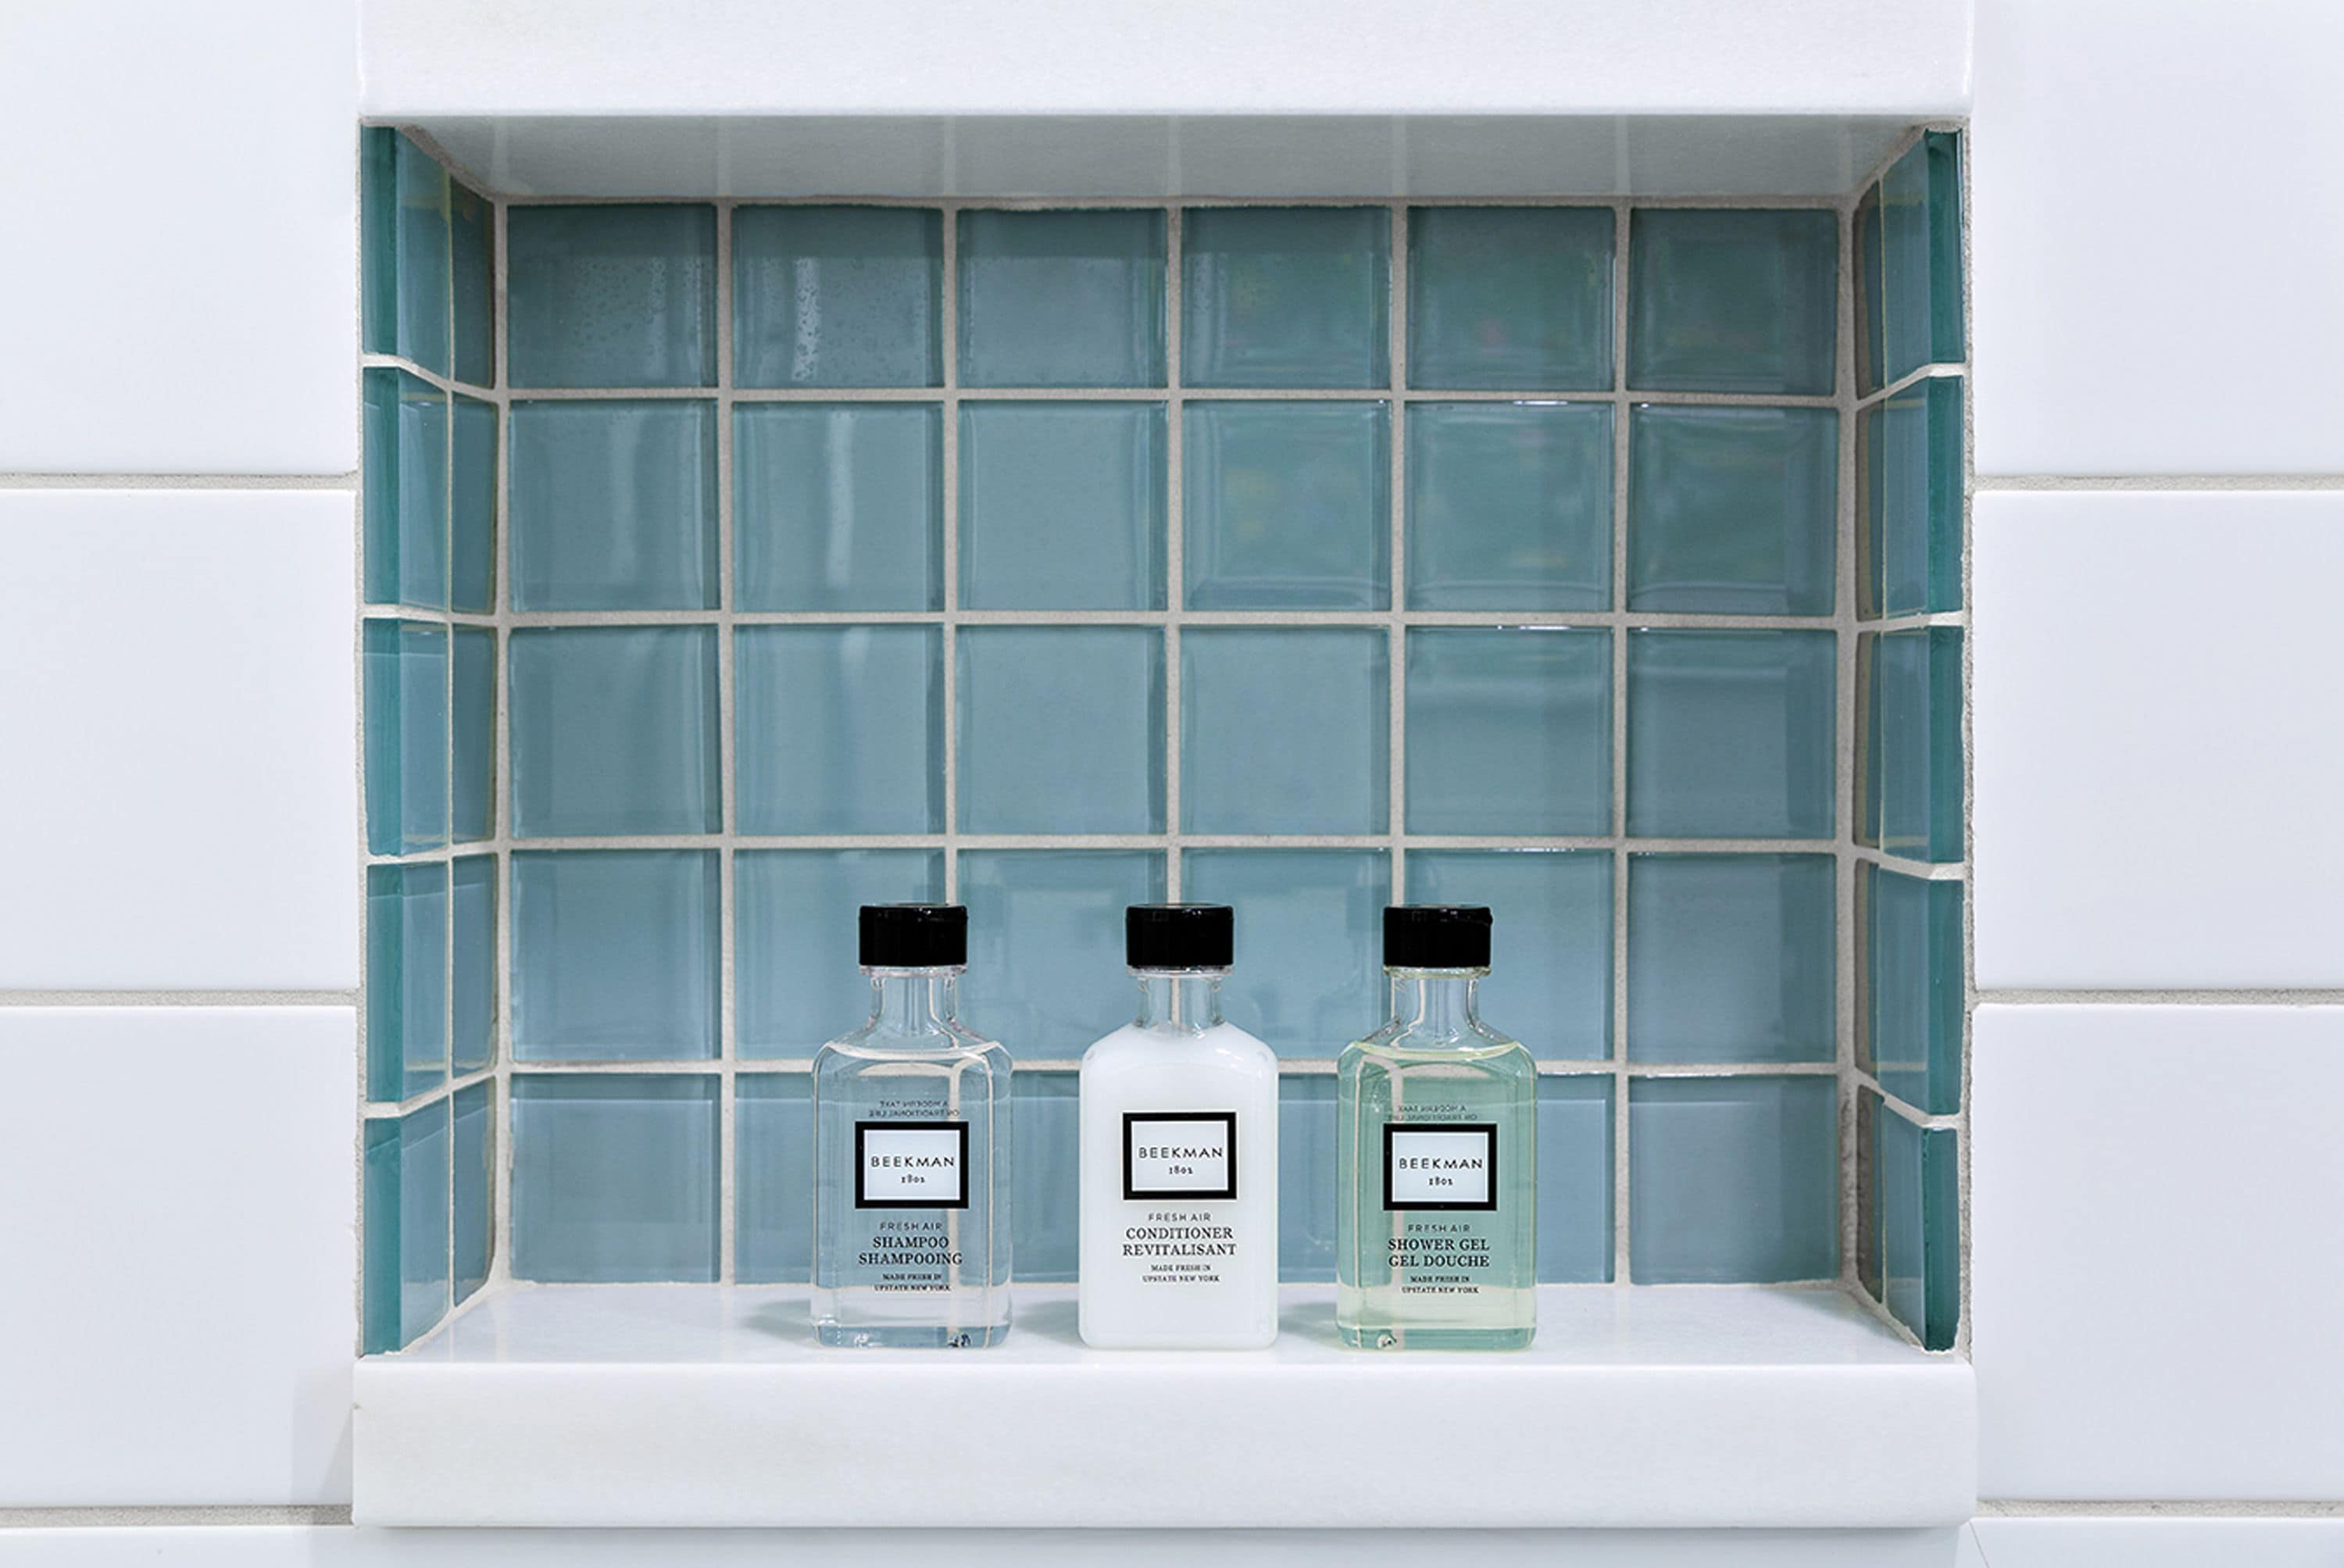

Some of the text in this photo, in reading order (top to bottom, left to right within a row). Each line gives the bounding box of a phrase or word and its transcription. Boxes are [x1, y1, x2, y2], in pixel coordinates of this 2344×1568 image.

[1138, 1147, 1223, 1159] BEEKMAN
[871, 1156, 955, 1167] BEEKMAN
[1399, 1158, 1483, 1169] BEEKMAN
[1149, 1213, 1211, 1222] FRESH AIR
[880, 1222, 943, 1230] FRESH AIR
[1408, 1224, 1470, 1233] FRESH AIR
[1125, 1227, 1234, 1239] CONDITIONER
[873, 1236, 949, 1248] SHAMPOO
[1388, 1238, 1490, 1251] SHOWER GEL
[1122, 1244, 1237, 1256] REVITALISANT
[859, 1252, 963, 1265] SHAMPOOING
[1388, 1255, 1490, 1267] GEL DOUCHE
